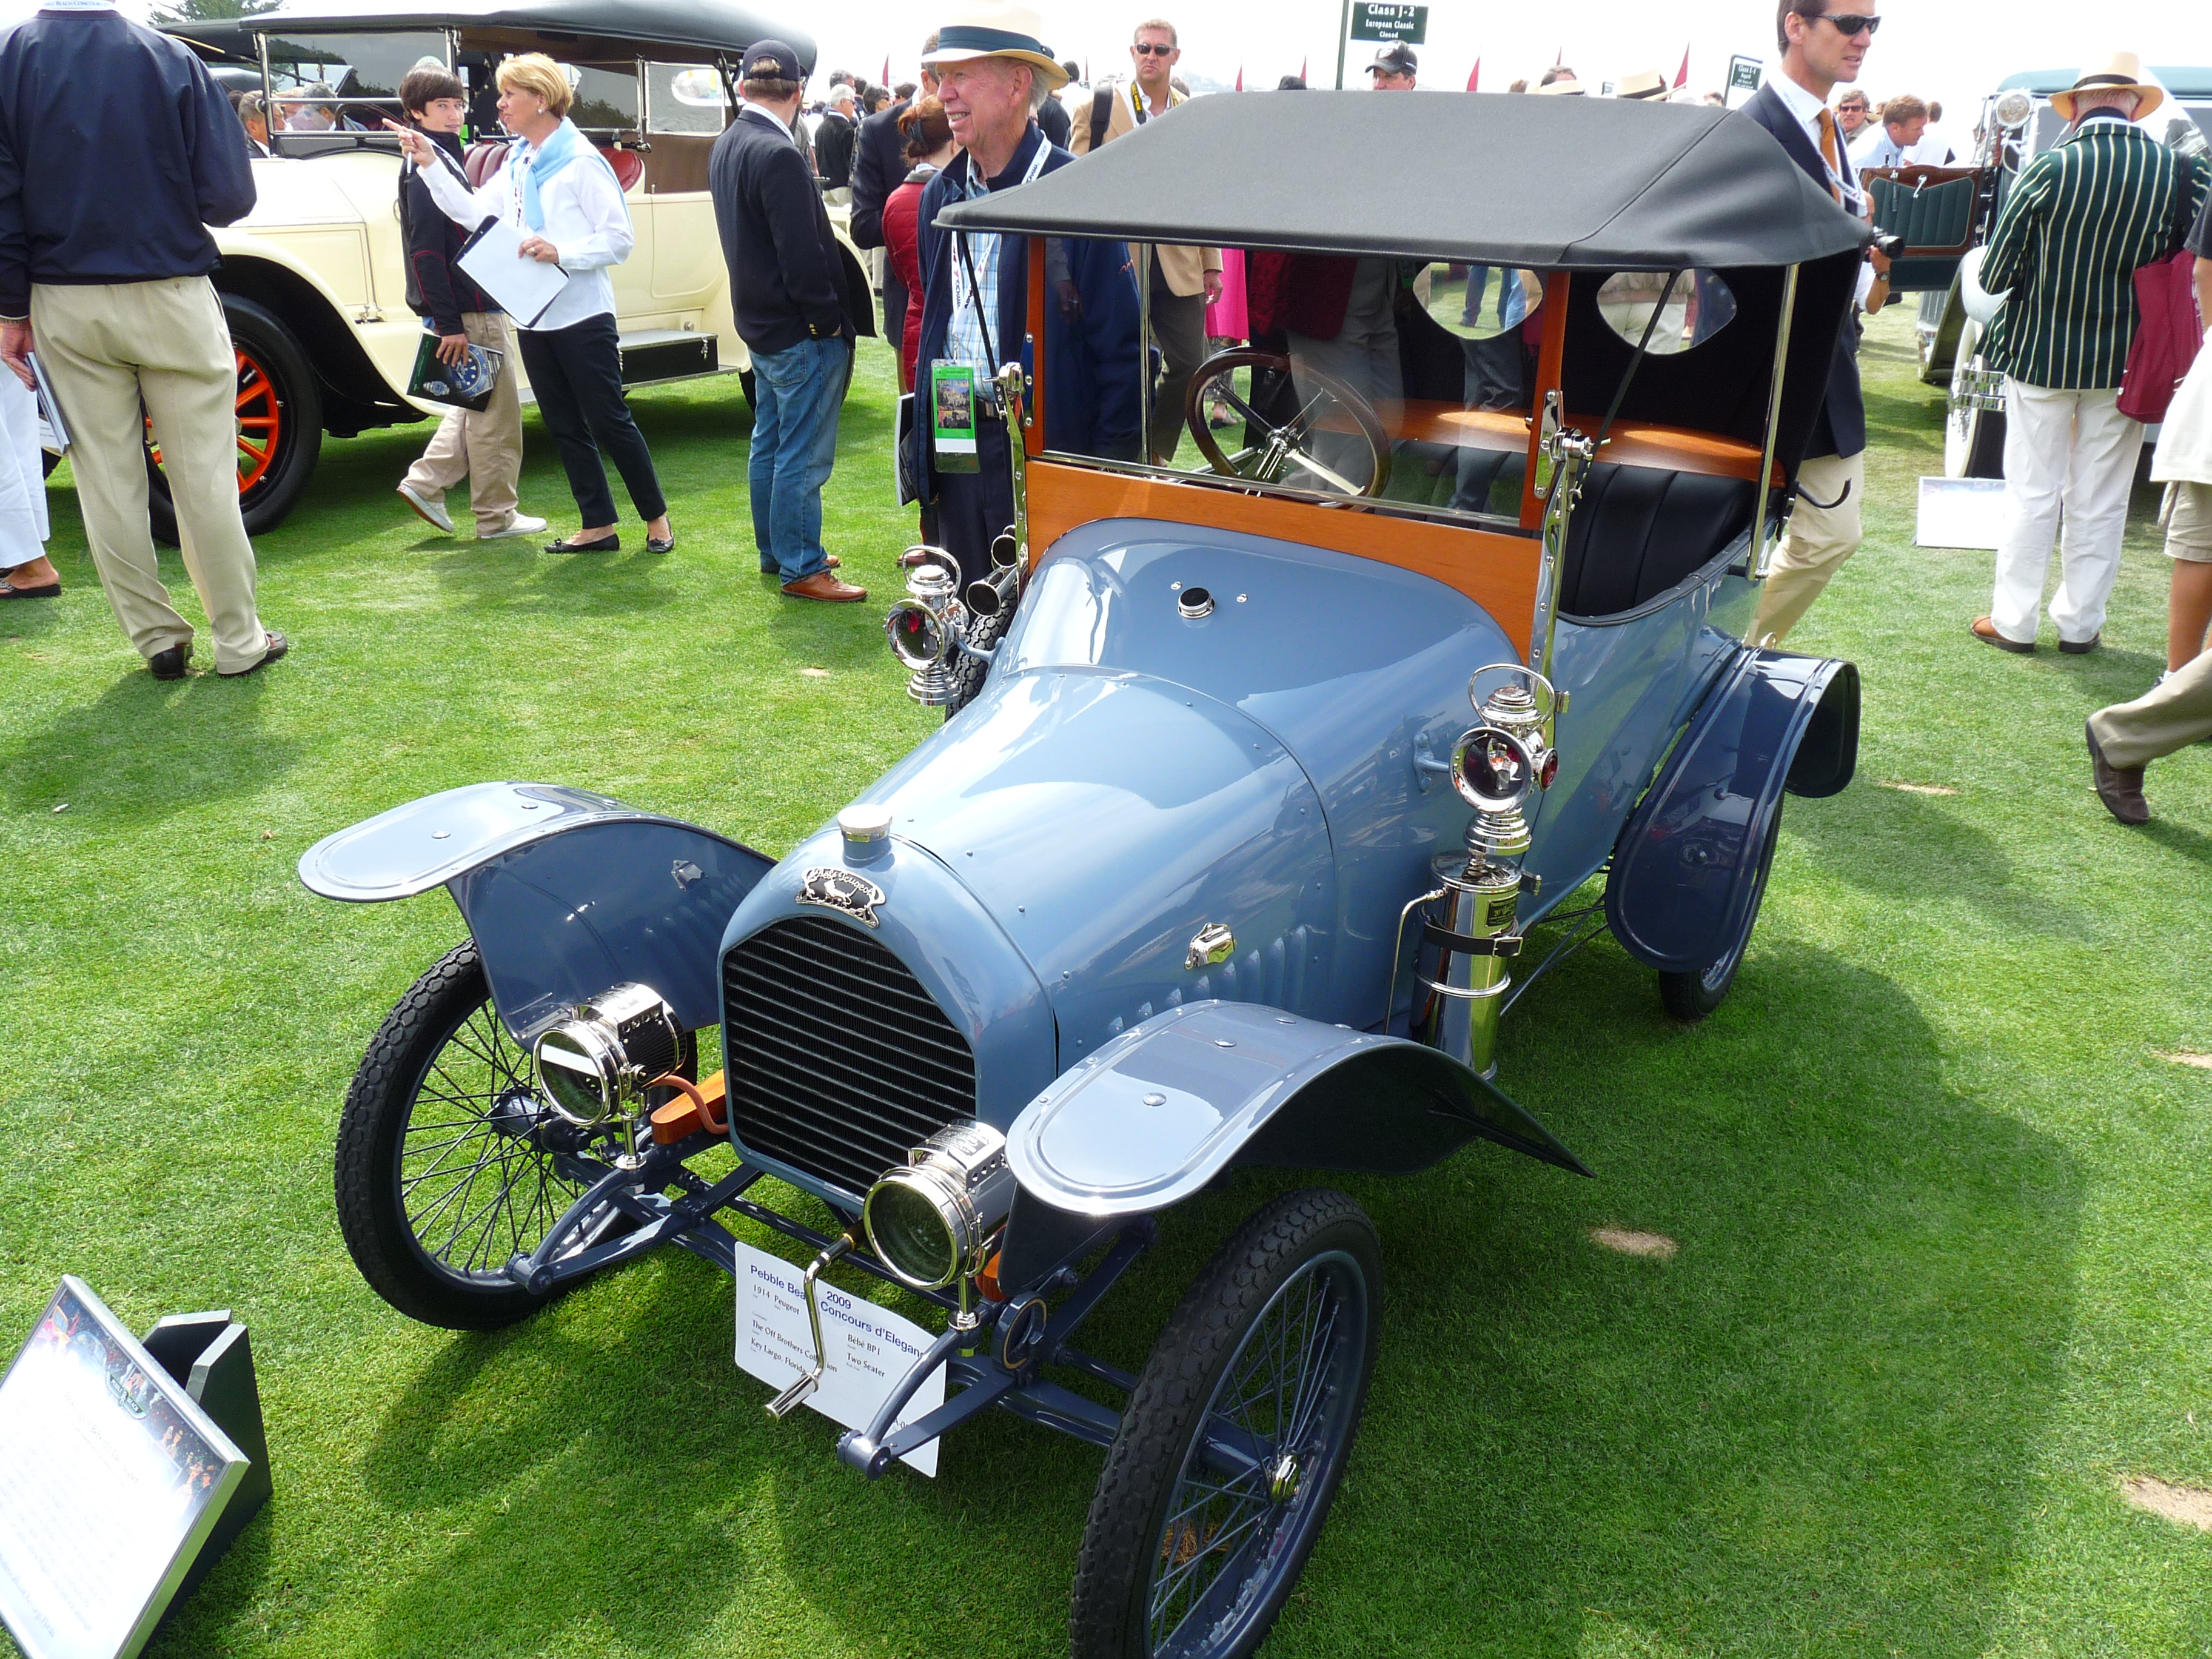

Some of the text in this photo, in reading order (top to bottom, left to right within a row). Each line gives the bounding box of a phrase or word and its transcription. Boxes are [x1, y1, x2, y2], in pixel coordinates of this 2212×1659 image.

[1366, 19, 1414, 29] European Classic
[1368, 4, 1415, 18] Class J-2
[751, 1265, 923, 1358] Pebble Bea Concours d'Elegan
[754, 1284, 800, 1315] 1914 Peugeot
[826, 1291, 851, 1309] 2009
[752, 1320, 763, 1332] The
[765, 1327, 776, 1338] Off
[777, 1333, 803, 1354] Brothers
[805, 1350, 837, 1372] Collion
[848, 1334, 865, 1348] Bébé
[751, 1337, 763, 1352] Key
[785, 1356, 806, 1373] Florida
[847, 1352, 862, 1366] Two
[863, 1361, 886, 1378] Seater
